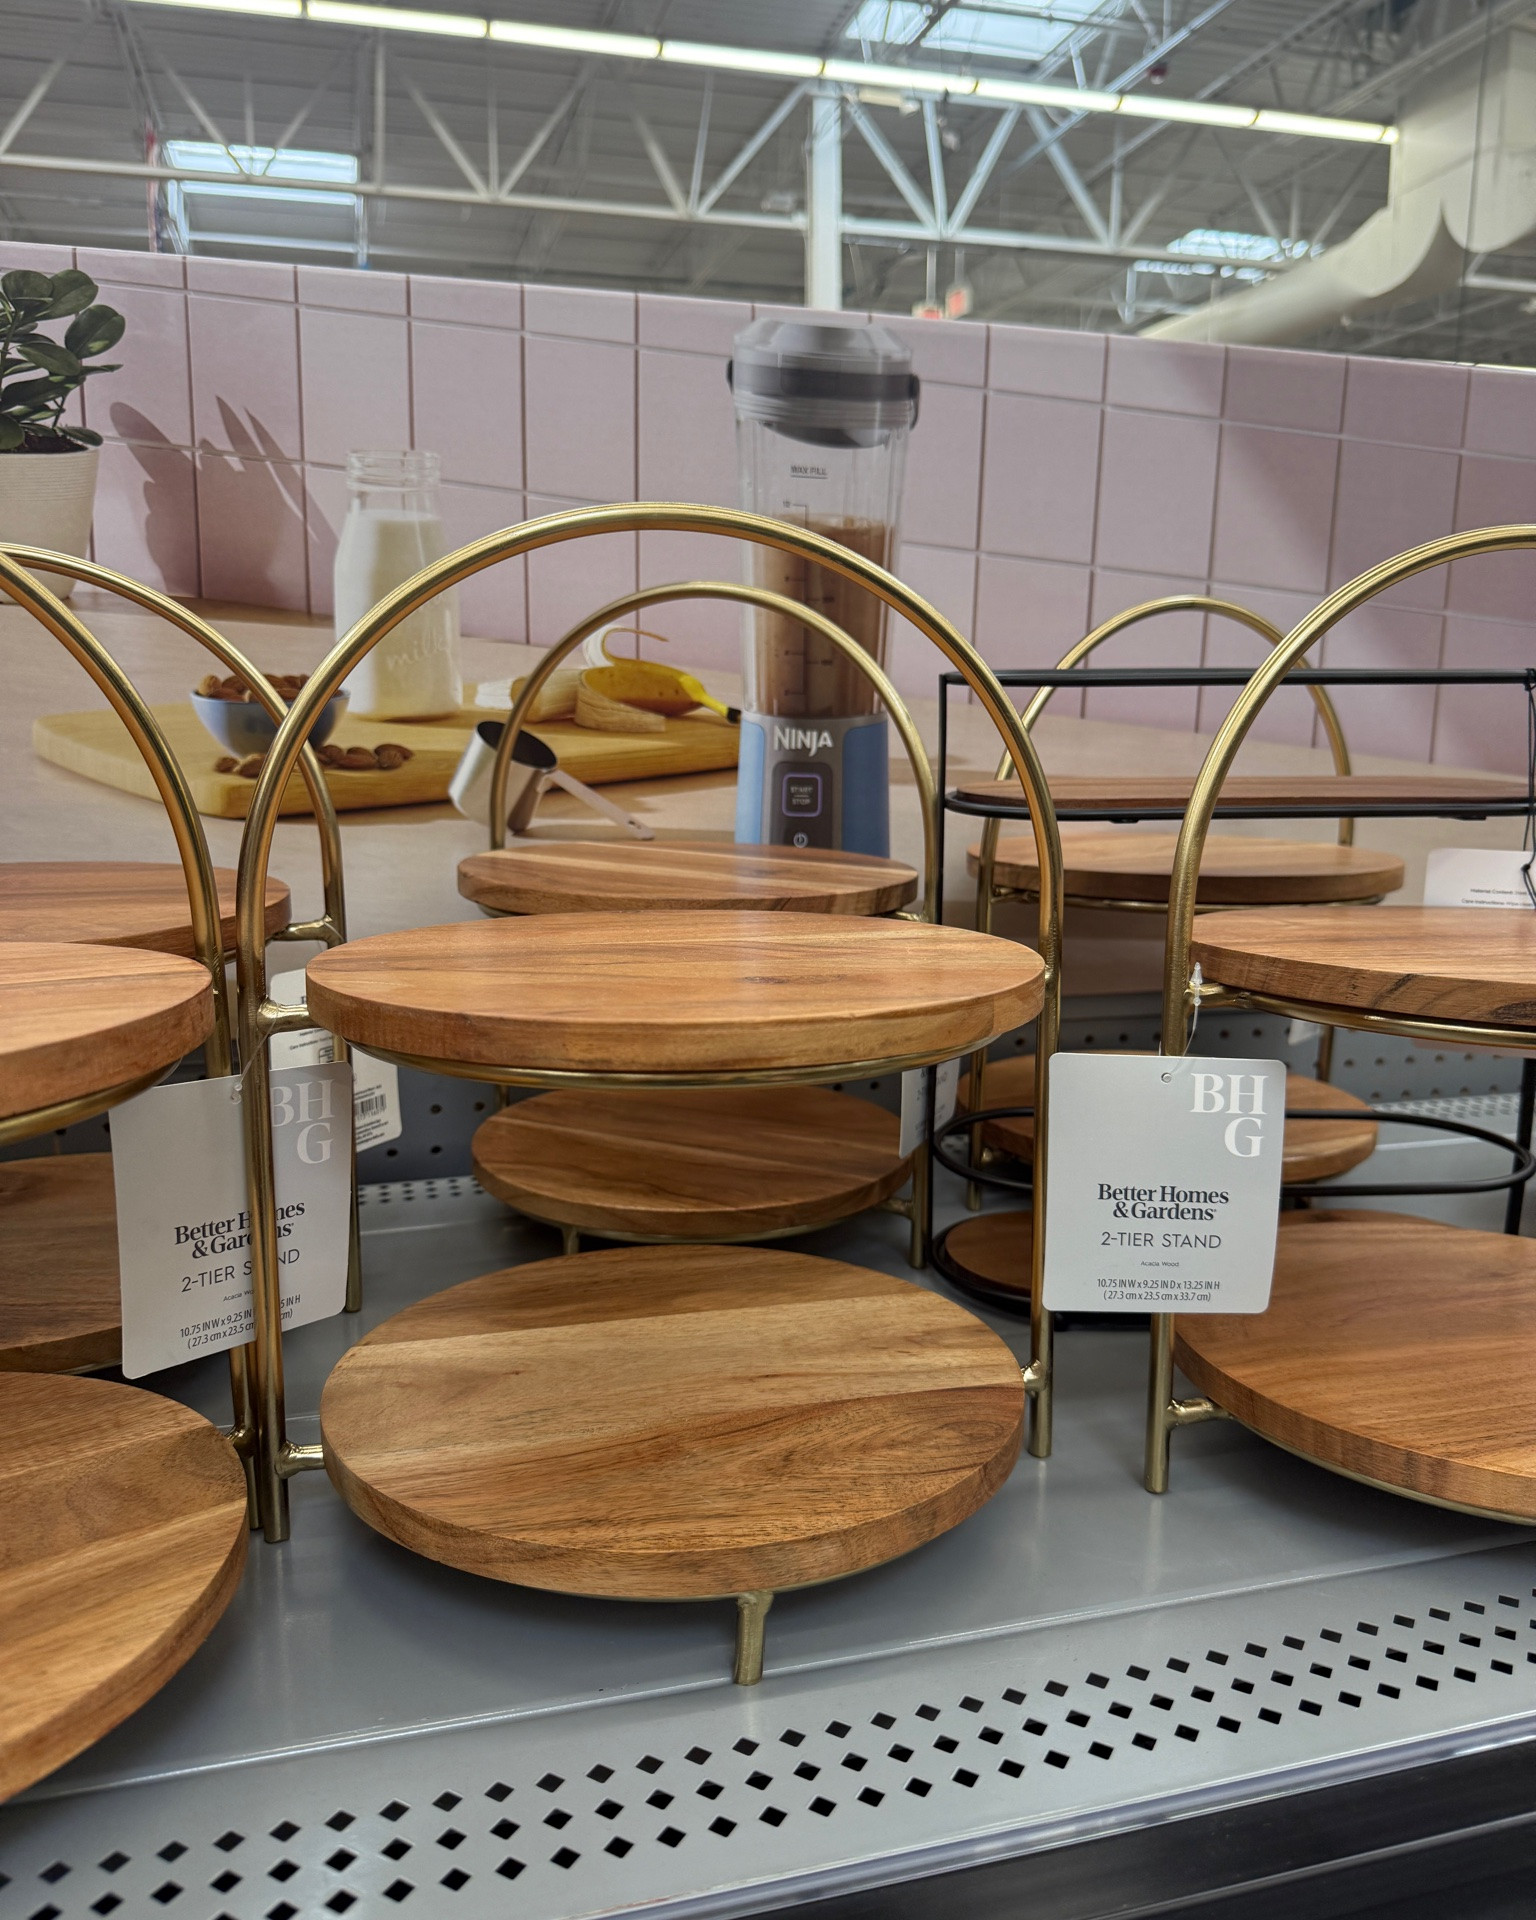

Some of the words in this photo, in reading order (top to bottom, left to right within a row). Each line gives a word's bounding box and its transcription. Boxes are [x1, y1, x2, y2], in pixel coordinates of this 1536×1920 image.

[774, 725, 834, 757] NINJA
[270, 1078, 335, 1128] BH
[1189, 1073, 1269, 1115] BH
[297, 1122, 334, 1165] G
[1224, 1117, 1265, 1158] G
[1097, 1183, 1157, 1202] Better
[1160, 1185, 1230, 1205] Homes
[1112, 1201, 1129, 1219] &
[174, 1218, 236, 1245] Better
[237, 1202, 306, 1230] Hes
[192, 1239, 210, 1260] &
[1100, 1231, 1154, 1247] 2-TIER
[1161, 1233, 1222, 1249] STAND
[181, 1265, 236, 1293] 2-TIER
[243, 1248, 300, 1276] SND
[1097, 1278, 1118, 1288] 10.75
[1137, 1281, 1142, 1289] x
[1143, 1279, 1160, 1289] 9.25
[1176, 1282, 1182, 1290] x
[1183, 1280, 1204, 1290] 13.25
[1143, 1291, 1160, 1301] 23.5
[1161, 1293, 1173, 1301] cm
[1173, 1293, 1179, 1301] x
[1179, 1292, 1196, 1301] 33.7
[223, 1293, 243, 1302] Acacia
[180, 1325, 201, 1338] 10.75
[226, 1312, 243, 1325] 9.25
[209, 1332, 222, 1342] cm
[228, 1324, 245, 1337] 23.5
